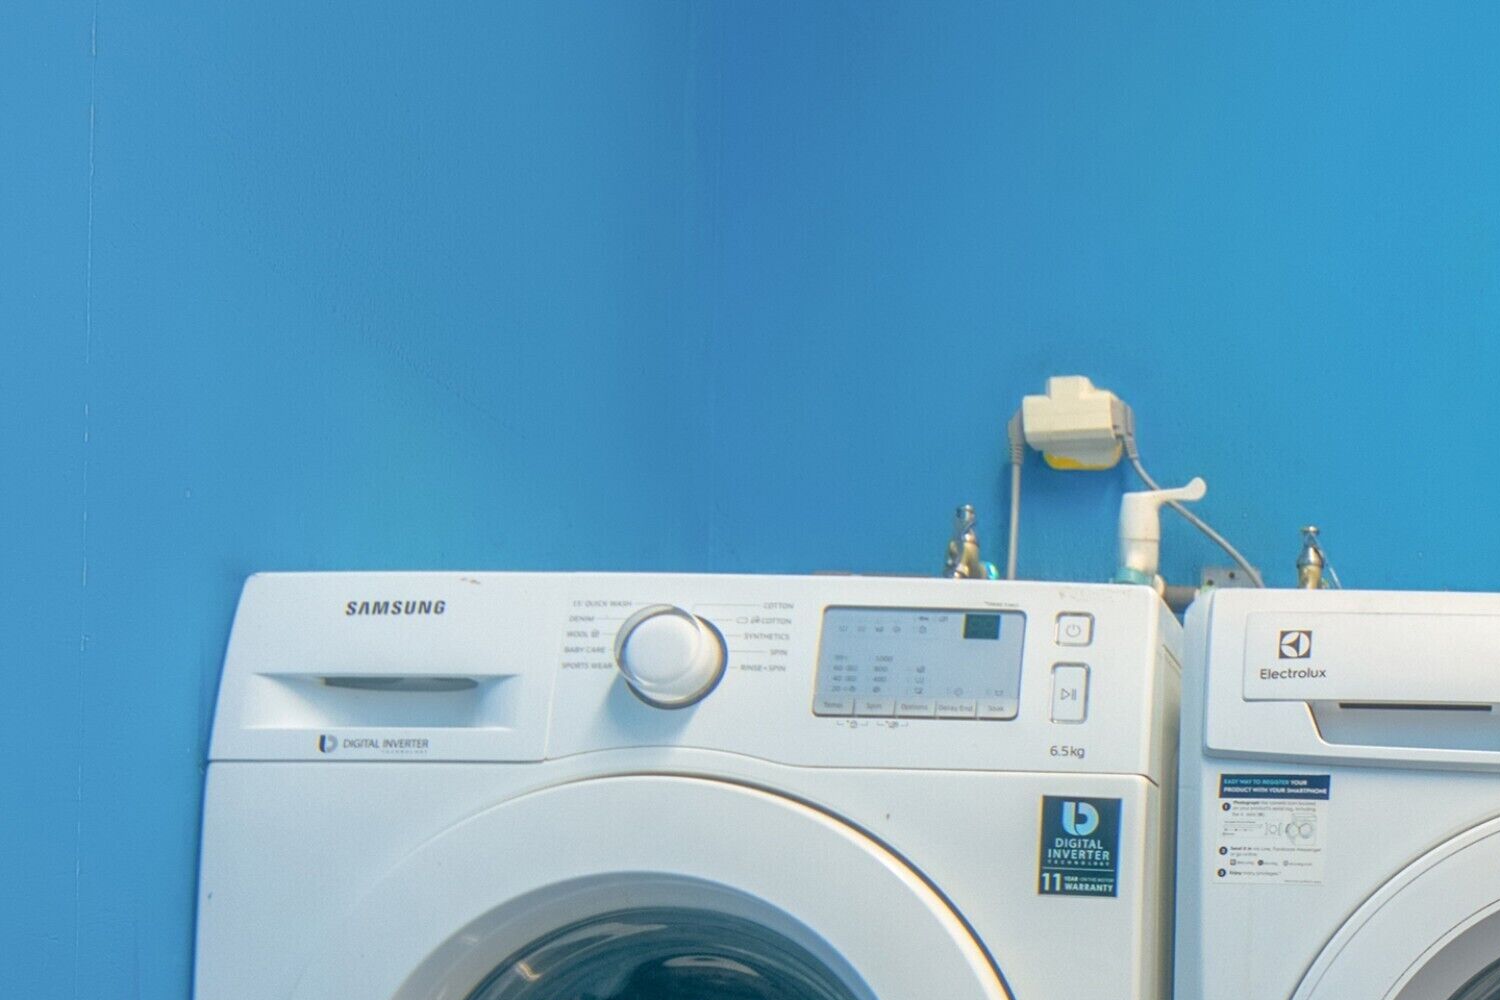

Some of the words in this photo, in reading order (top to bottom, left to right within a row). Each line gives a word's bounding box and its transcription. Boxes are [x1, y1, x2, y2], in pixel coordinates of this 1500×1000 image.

[346, 600, 446, 616] SAMSUNG
[585, 600, 608, 608] QUICK
[610, 600, 632, 608] WASH
[567, 630, 588, 638] WOOL
[744, 632, 790, 640] SYNTHETICS
[561, 661, 588, 669] SPORTS
[1260, 667, 1327, 680] Electrolux
[938, 703, 959, 712] Delay
[960, 704, 973, 712] End
[343, 738, 380, 748] DIGITAL
[382, 739, 429, 749] INVERTER
[1291, 779, 1307, 787] YOUR
[1287, 788, 1328, 796] SMARTPHONE
[1055, 838, 1103, 849] DIGITAL
[1048, 848, 1110, 860] INVERTER
[1042, 872, 1062, 891] 11
[1064, 883, 1114, 892] WARRANTY
